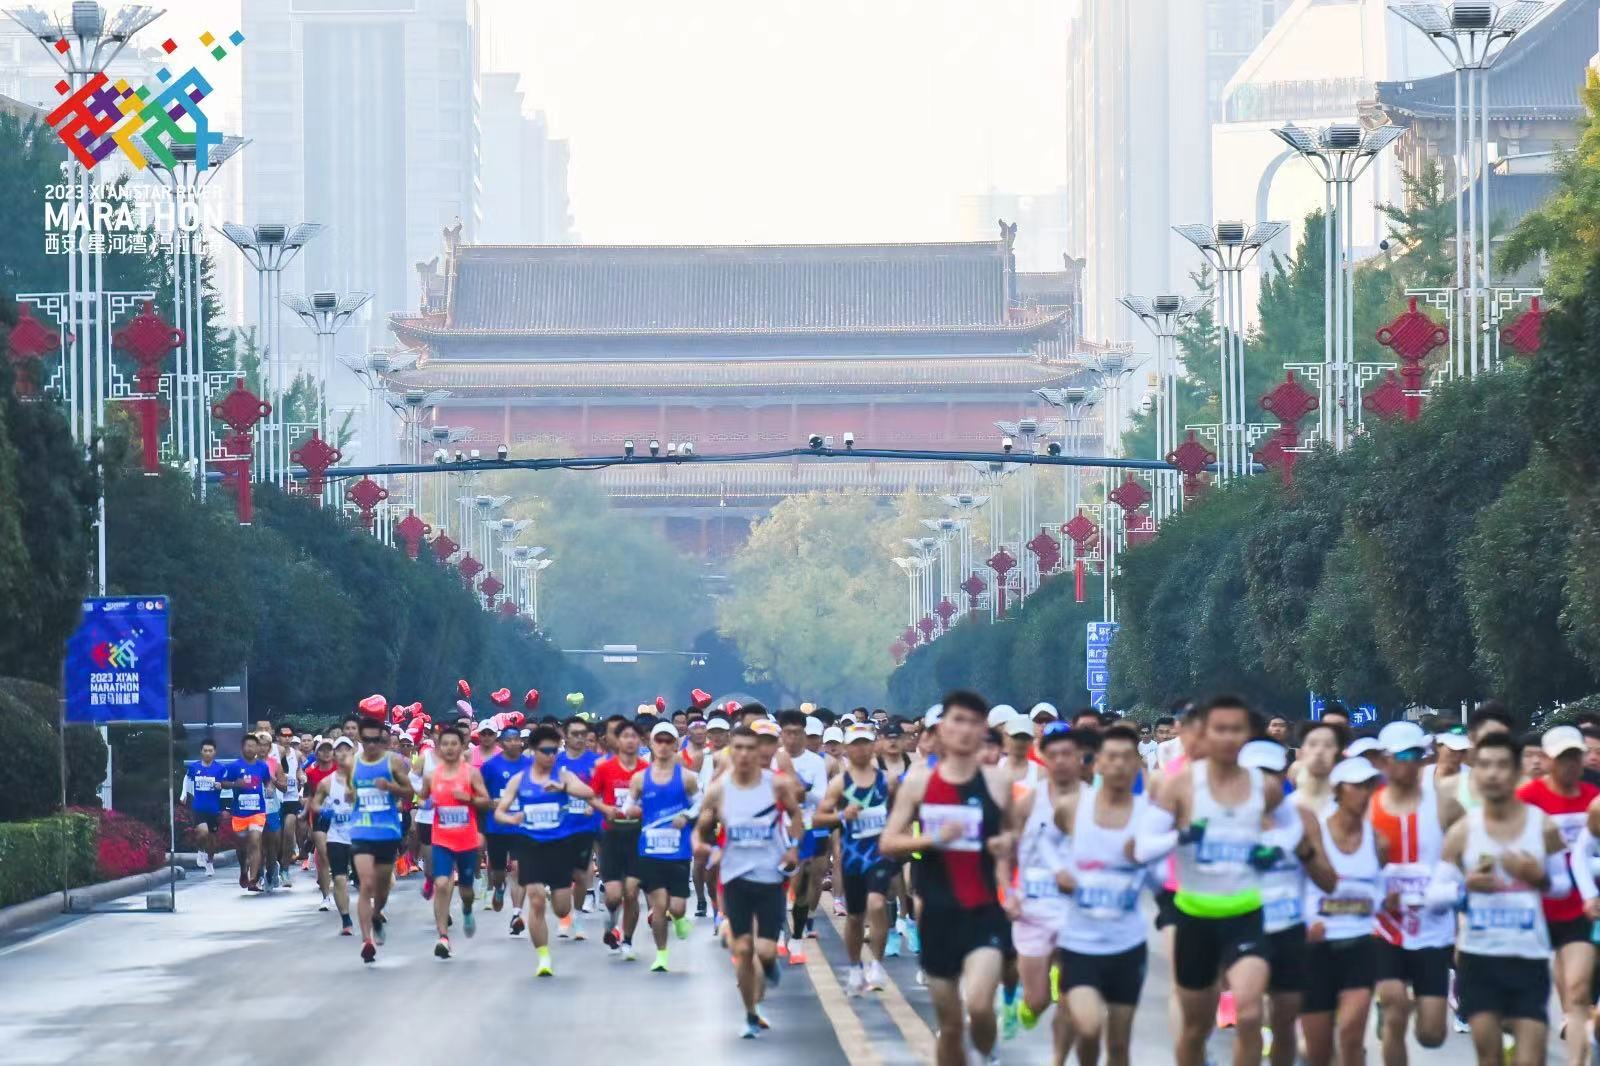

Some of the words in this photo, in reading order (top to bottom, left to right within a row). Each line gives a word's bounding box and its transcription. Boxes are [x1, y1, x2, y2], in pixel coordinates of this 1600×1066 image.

[90, 672, 114, 683] 2023
[115, 672, 139, 683] XI'AN
[90, 682, 140, 692] MARATHON
